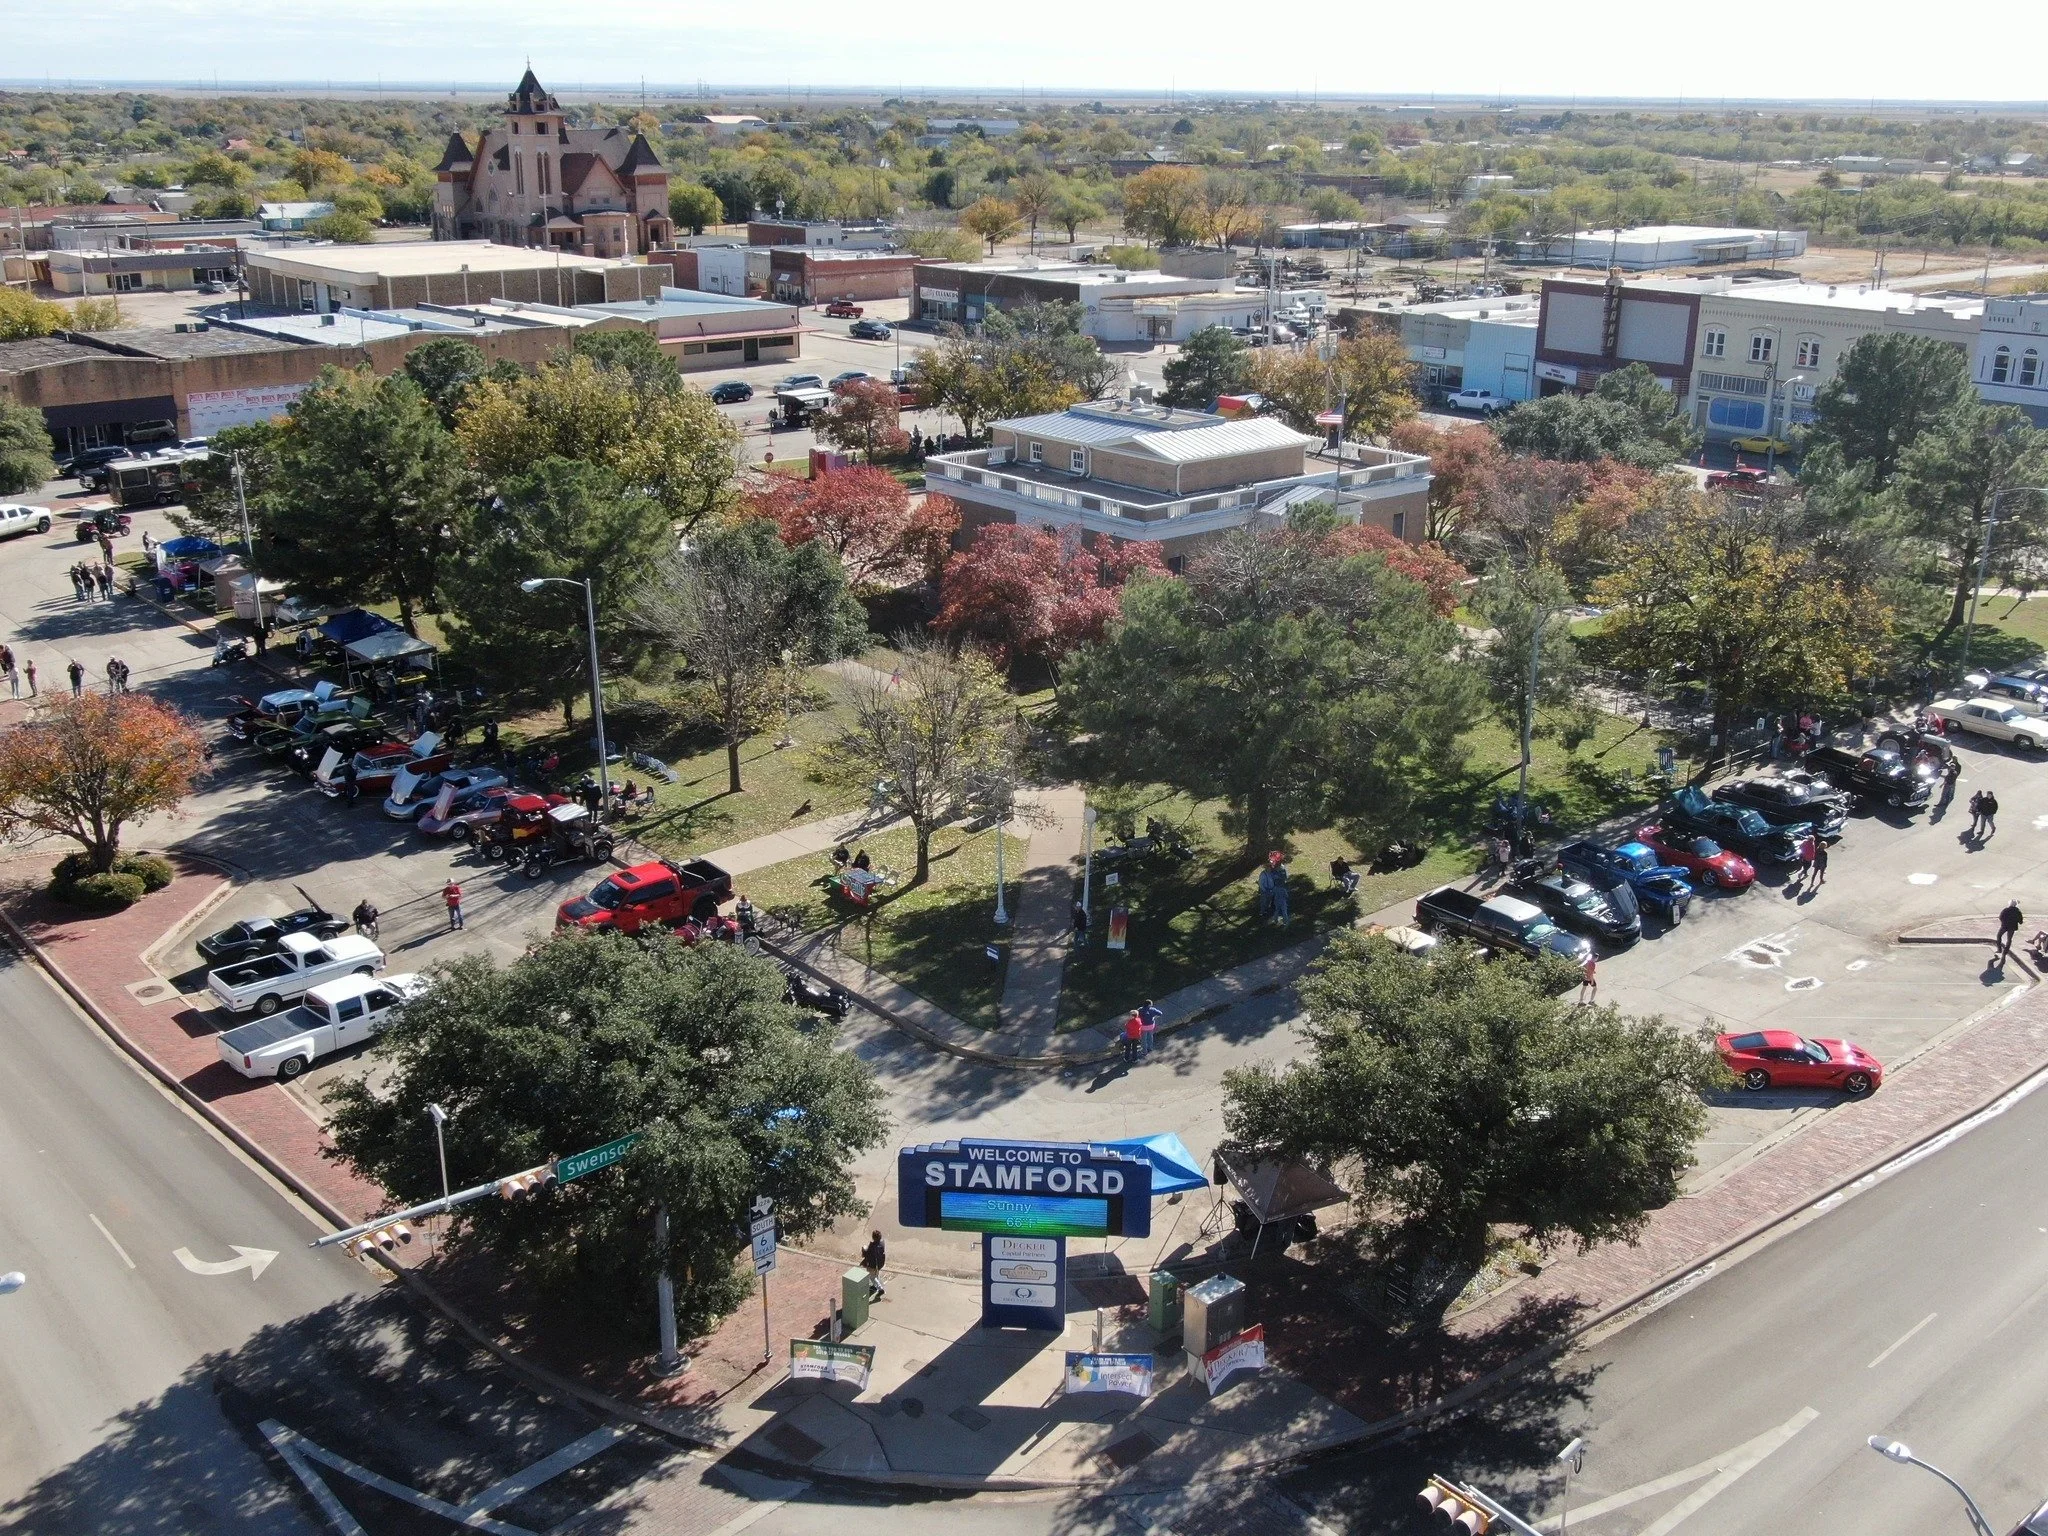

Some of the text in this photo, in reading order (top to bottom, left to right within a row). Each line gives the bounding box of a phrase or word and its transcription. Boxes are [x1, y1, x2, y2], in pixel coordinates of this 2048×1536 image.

[1607, 285, 1619, 347] GRAND
[968, 1148, 1081, 1165] WELCOME TO
[925, 1161, 1124, 1195] STAMFORD
[987, 1200, 1031, 1213] Sunny
[752, 1218, 774, 1233] SOUTH
[760, 1236, 768, 1247] 6
[1003, 1239, 1045, 1250] DECKER
[756, 1246, 773, 1257] TEXAS
[1101, 1372, 1132, 1381] Intersect
[1109, 1379, 1132, 1388] Power
